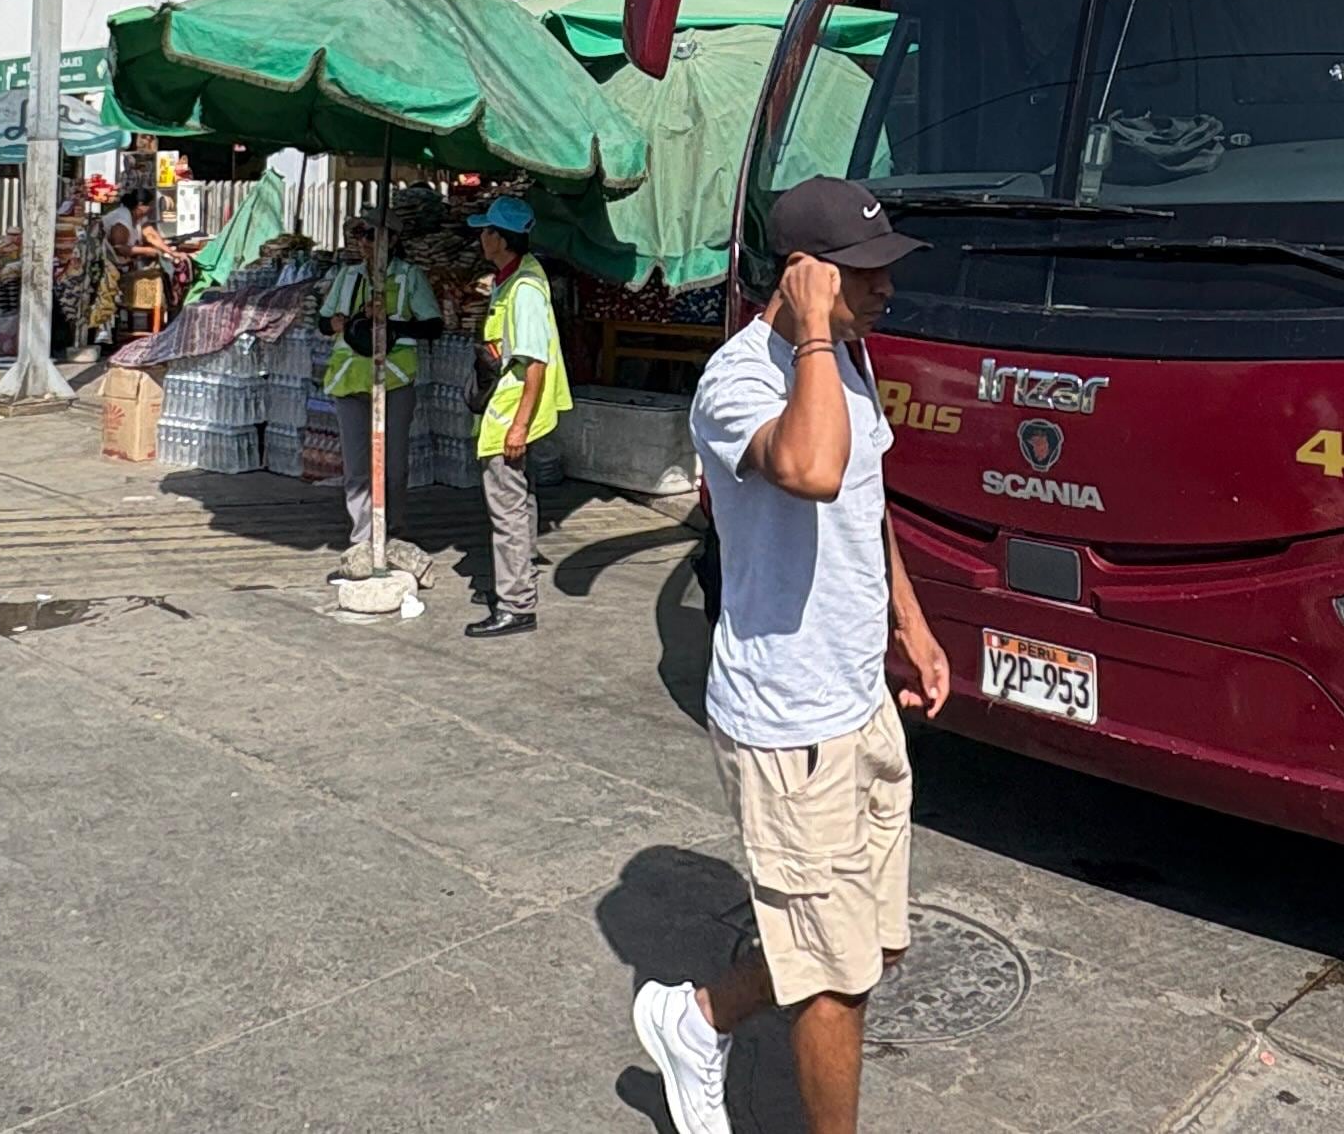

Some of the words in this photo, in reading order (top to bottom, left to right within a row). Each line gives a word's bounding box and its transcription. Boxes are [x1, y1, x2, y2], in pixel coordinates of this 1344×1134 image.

[878, 379, 964, 434] Bus
[982, 470, 1106, 512] SCANIA
[1017, 641, 1057, 663] PERU
[989, 648, 1090, 709] Y2P-953
